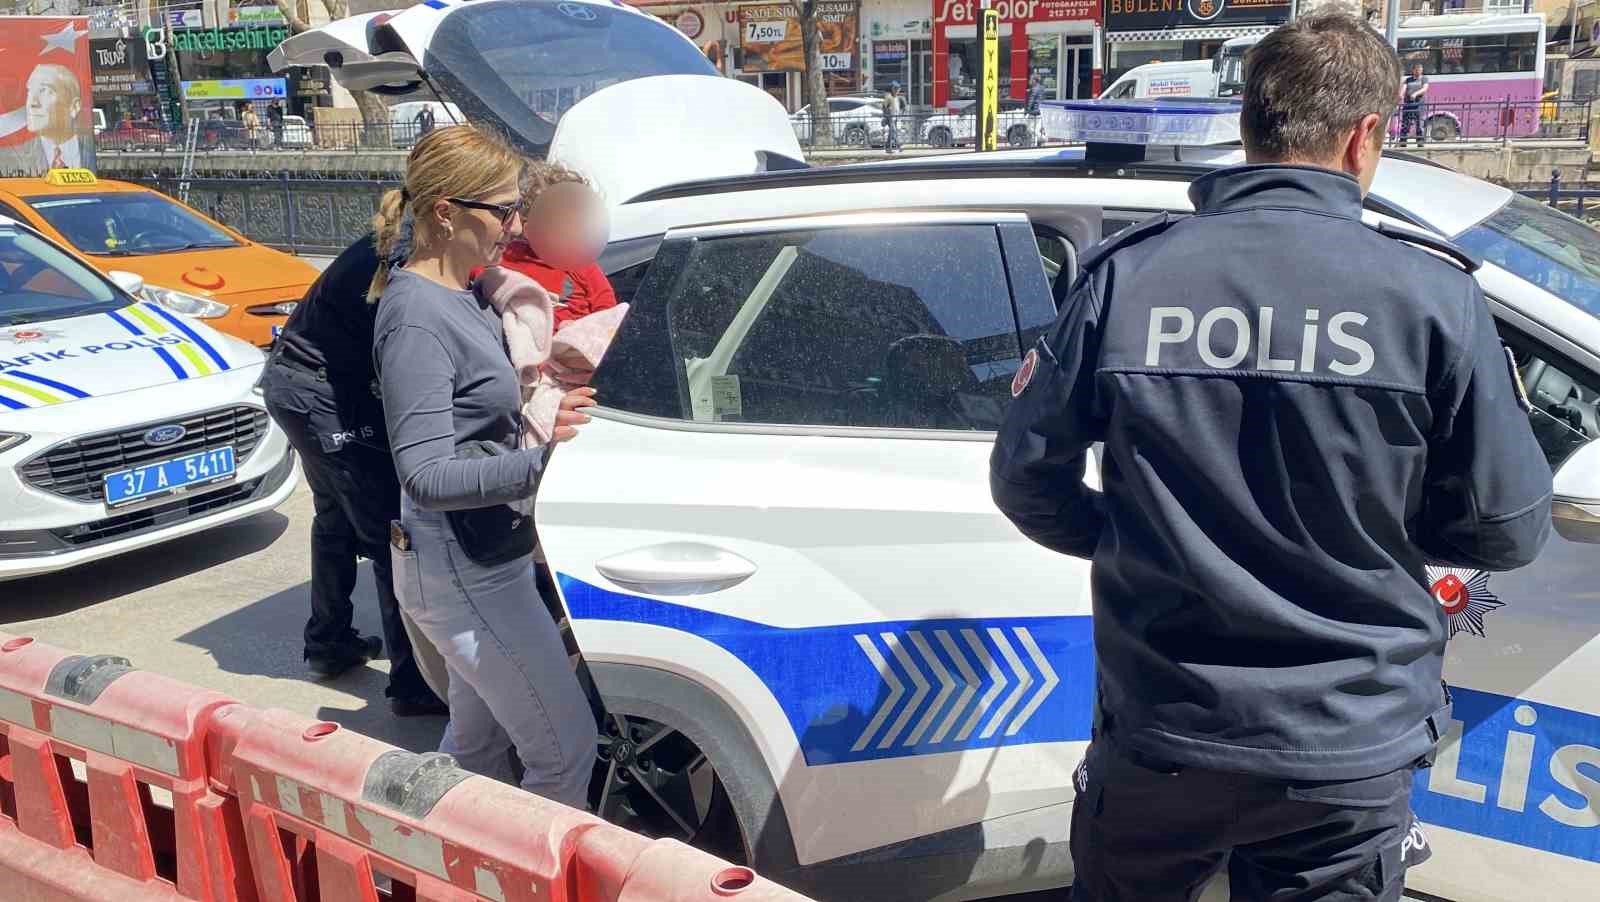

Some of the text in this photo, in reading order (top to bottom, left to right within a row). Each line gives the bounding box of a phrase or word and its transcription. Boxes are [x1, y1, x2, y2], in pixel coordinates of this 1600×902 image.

[934, 0, 1040, 22] Set olor
[122, 450, 229, 496] 37 A 5411
